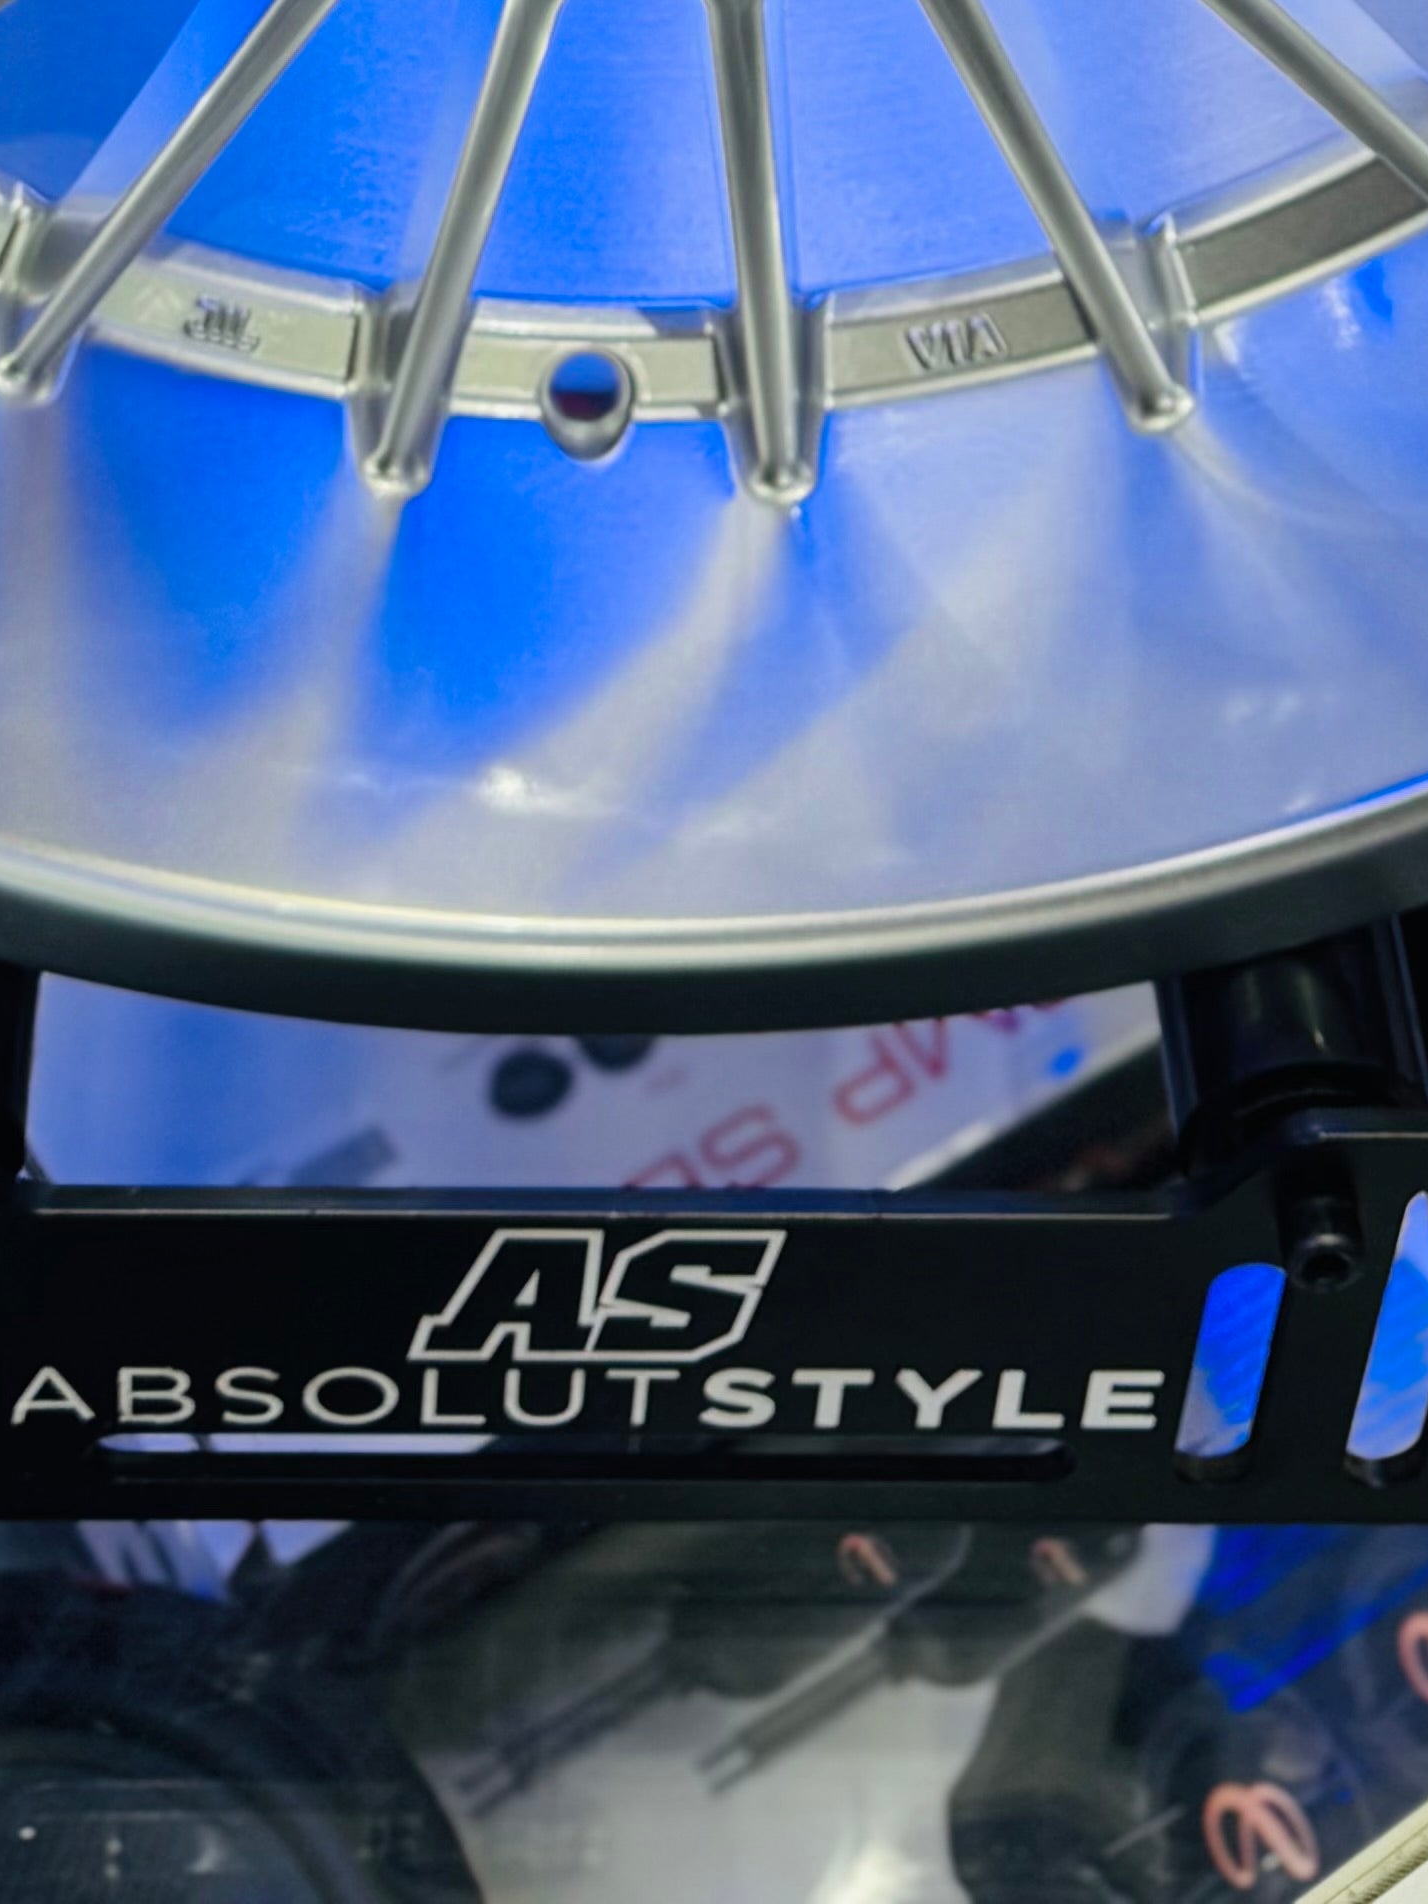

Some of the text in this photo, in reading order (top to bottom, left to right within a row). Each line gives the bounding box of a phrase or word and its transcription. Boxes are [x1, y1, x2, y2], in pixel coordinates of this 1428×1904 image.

[900, 311, 1008, 370] VIA
[407, 1228, 786, 1362] AS
[11, 1366, 1165, 1430] ABSOLUTSTYLE
